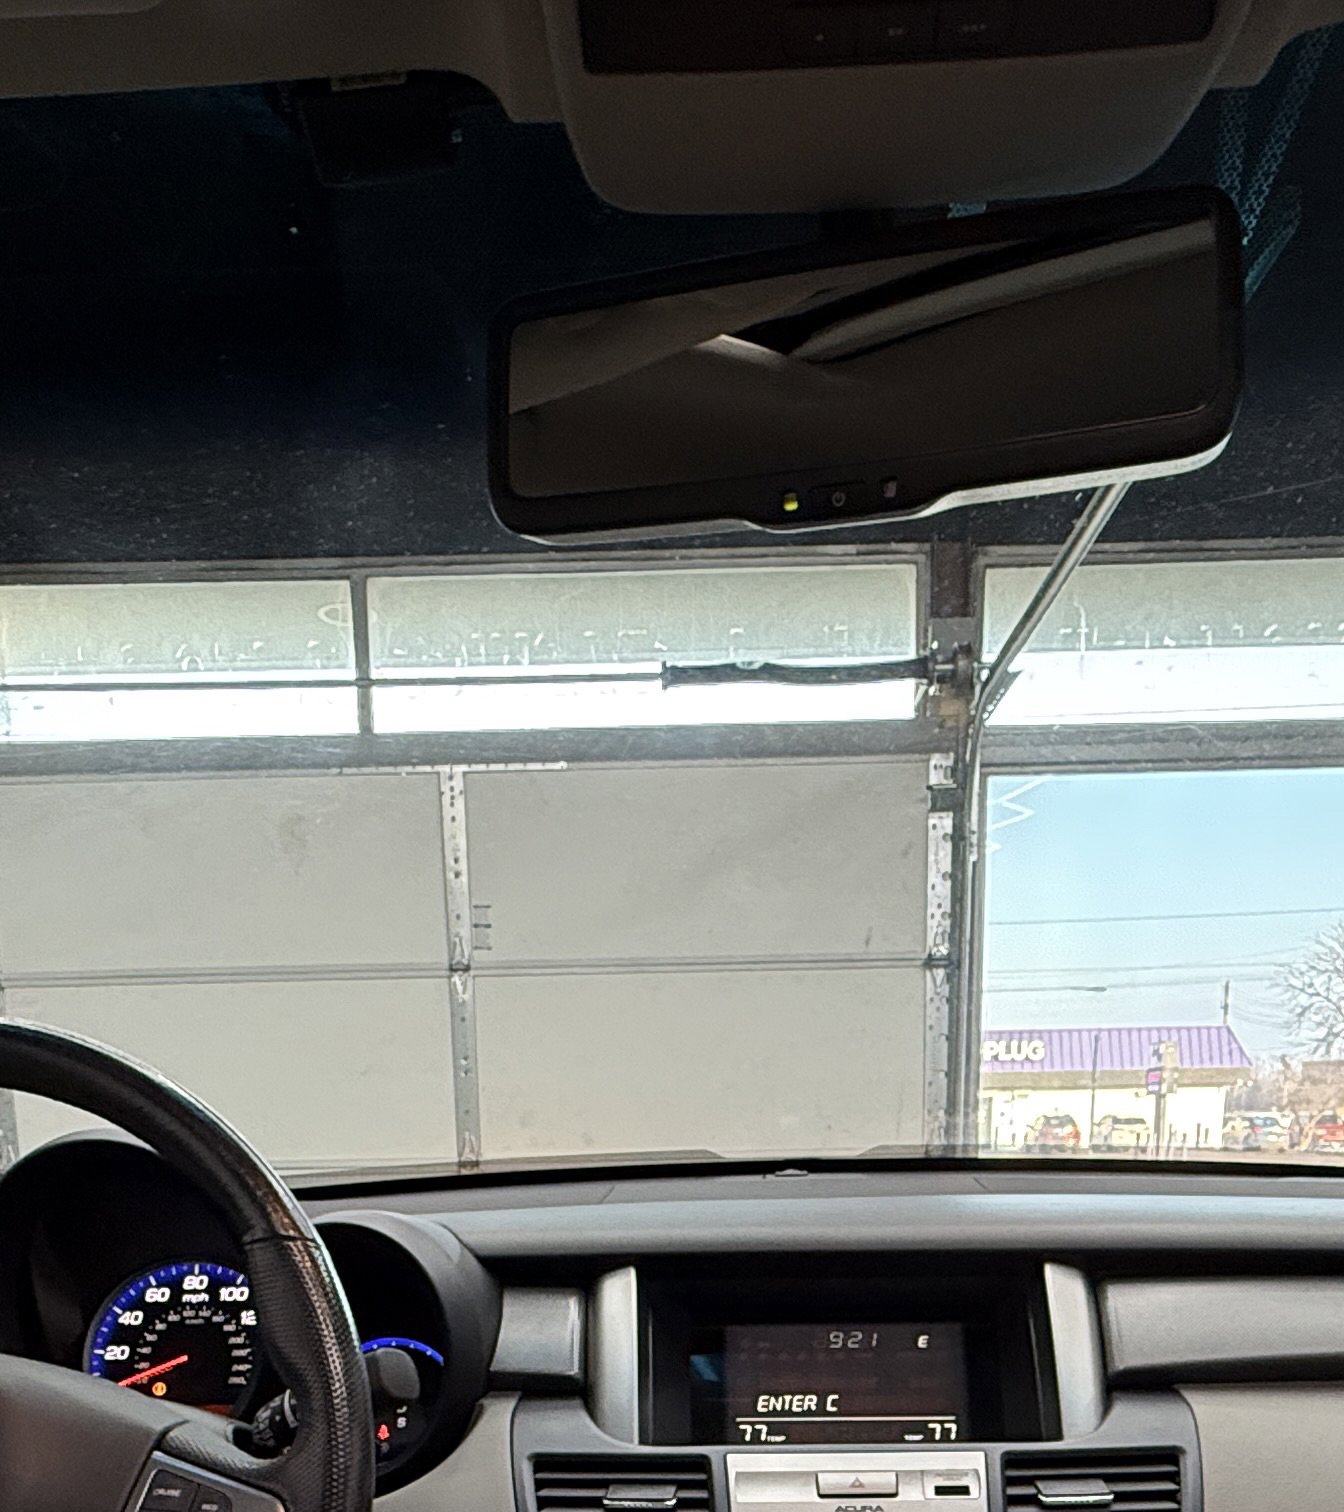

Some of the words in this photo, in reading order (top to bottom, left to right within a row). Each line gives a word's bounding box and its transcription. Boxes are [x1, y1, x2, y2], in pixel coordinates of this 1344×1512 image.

[982, 1039, 1045, 1061] PLUG
[182, 1275, 209, 1290] 80
[145, 1287, 171, 1302] 60
[182, 1292, 209, 1303] mph
[219, 1286, 249, 1302] 100
[118, 1310, 144, 1325] 40
[241, 1310, 257, 1325] 12
[104, 1345, 130, 1360] 20
[757, 1395, 818, 1412] ENTER
[826, 1394, 839, 1412] C
[738, 1424, 768, 1442] 77
[927, 1423, 958, 1440] 77
